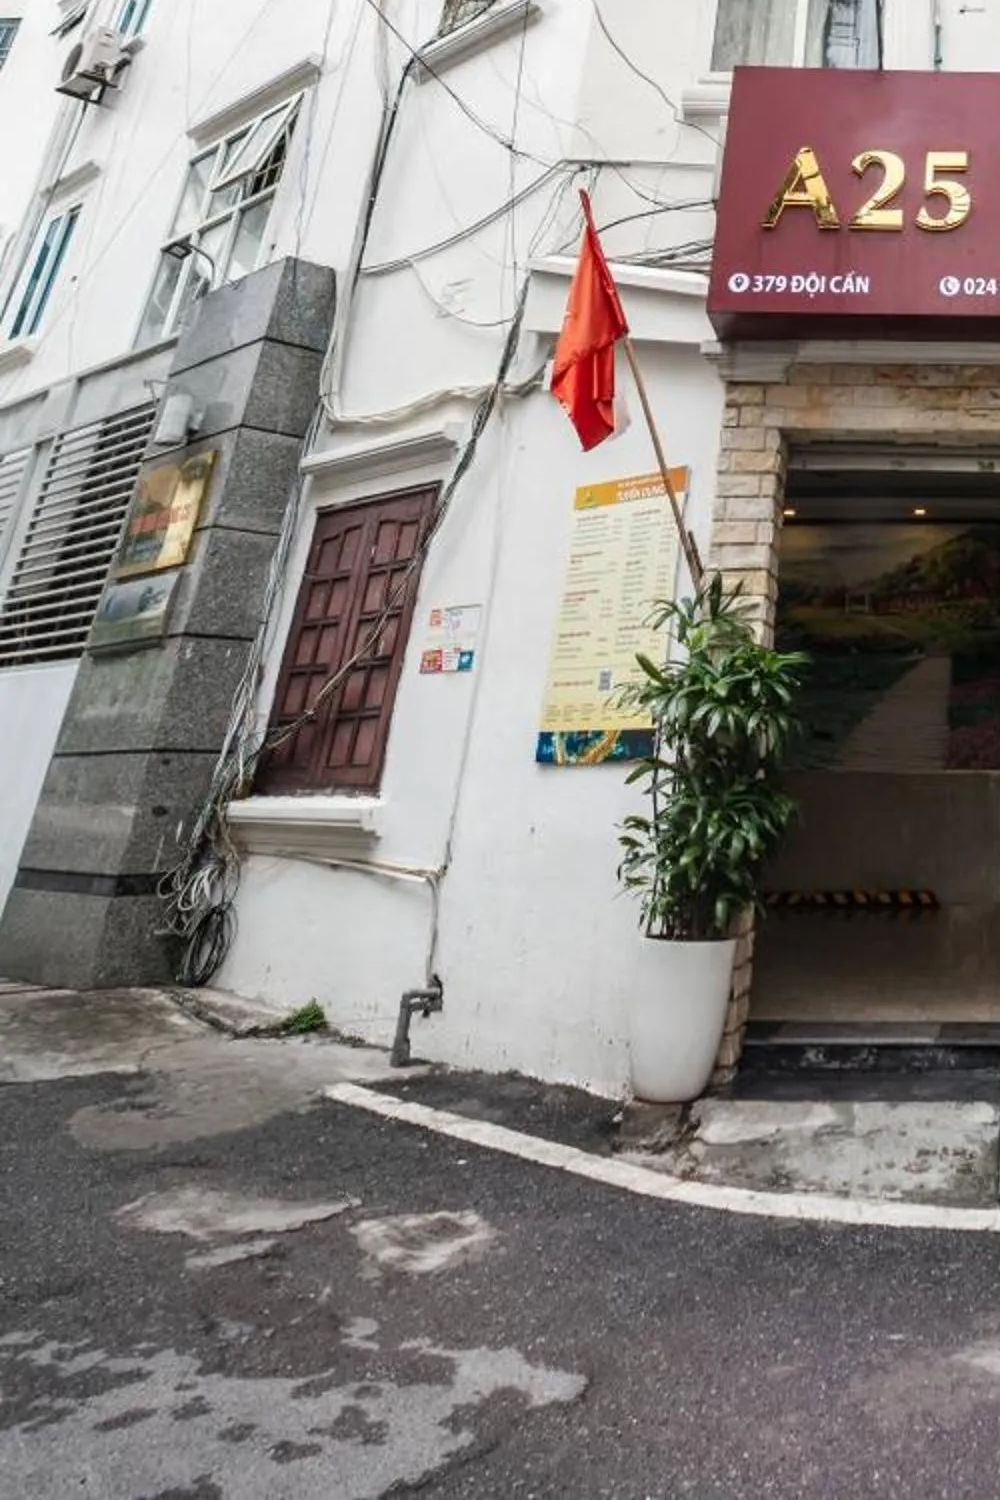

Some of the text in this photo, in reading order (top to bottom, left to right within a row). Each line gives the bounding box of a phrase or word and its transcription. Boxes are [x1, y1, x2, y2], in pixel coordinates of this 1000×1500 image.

[762, 146, 972, 231] A25
[752, 275, 787, 293] 379
[791, 272, 825, 298] ĐỘI
[963, 278, 997, 295] 024
